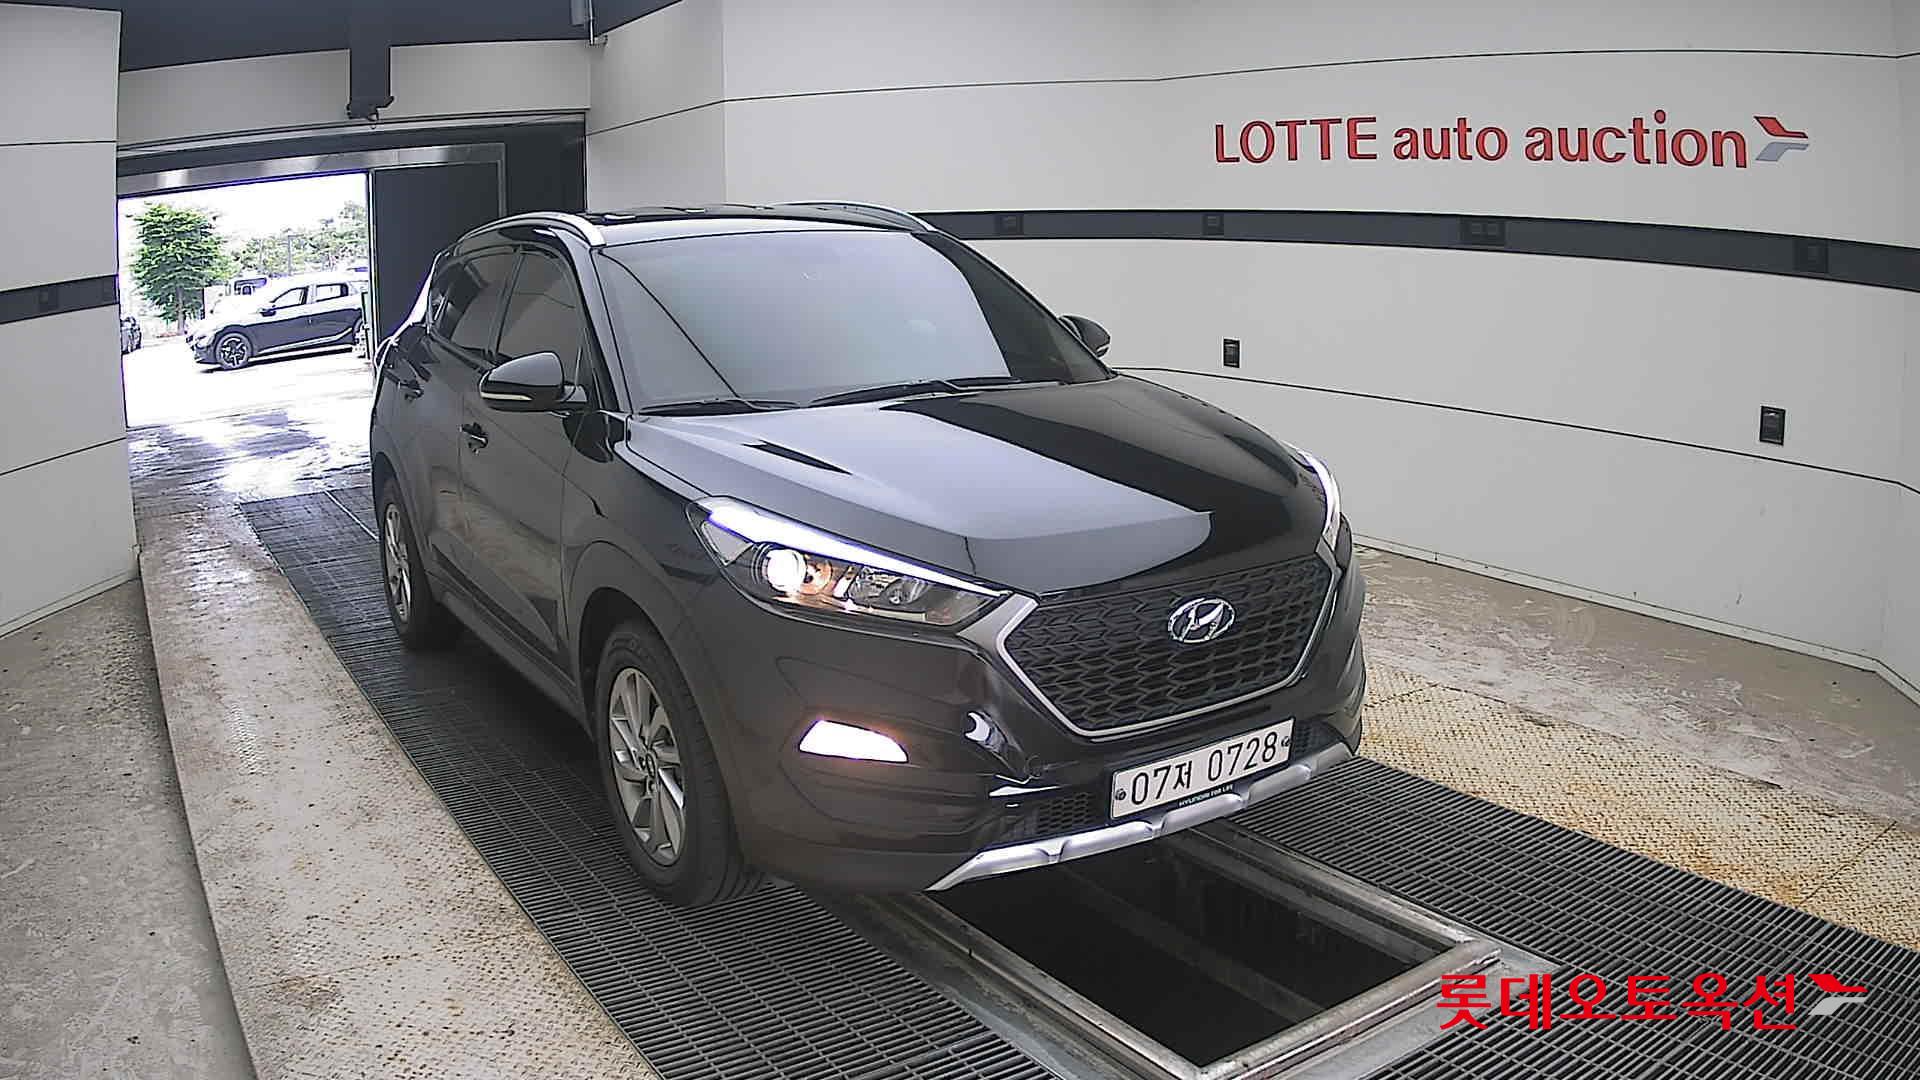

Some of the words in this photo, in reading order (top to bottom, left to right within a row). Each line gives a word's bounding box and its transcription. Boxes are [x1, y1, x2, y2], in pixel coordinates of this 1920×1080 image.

[1215, 117, 1377, 163] LOTTE
[1393, 117, 1510, 161] auto
[1524, 110, 1748, 168] auction
[1131, 760, 1193, 806] 07저
[1207, 731, 1278, 782] 0728
